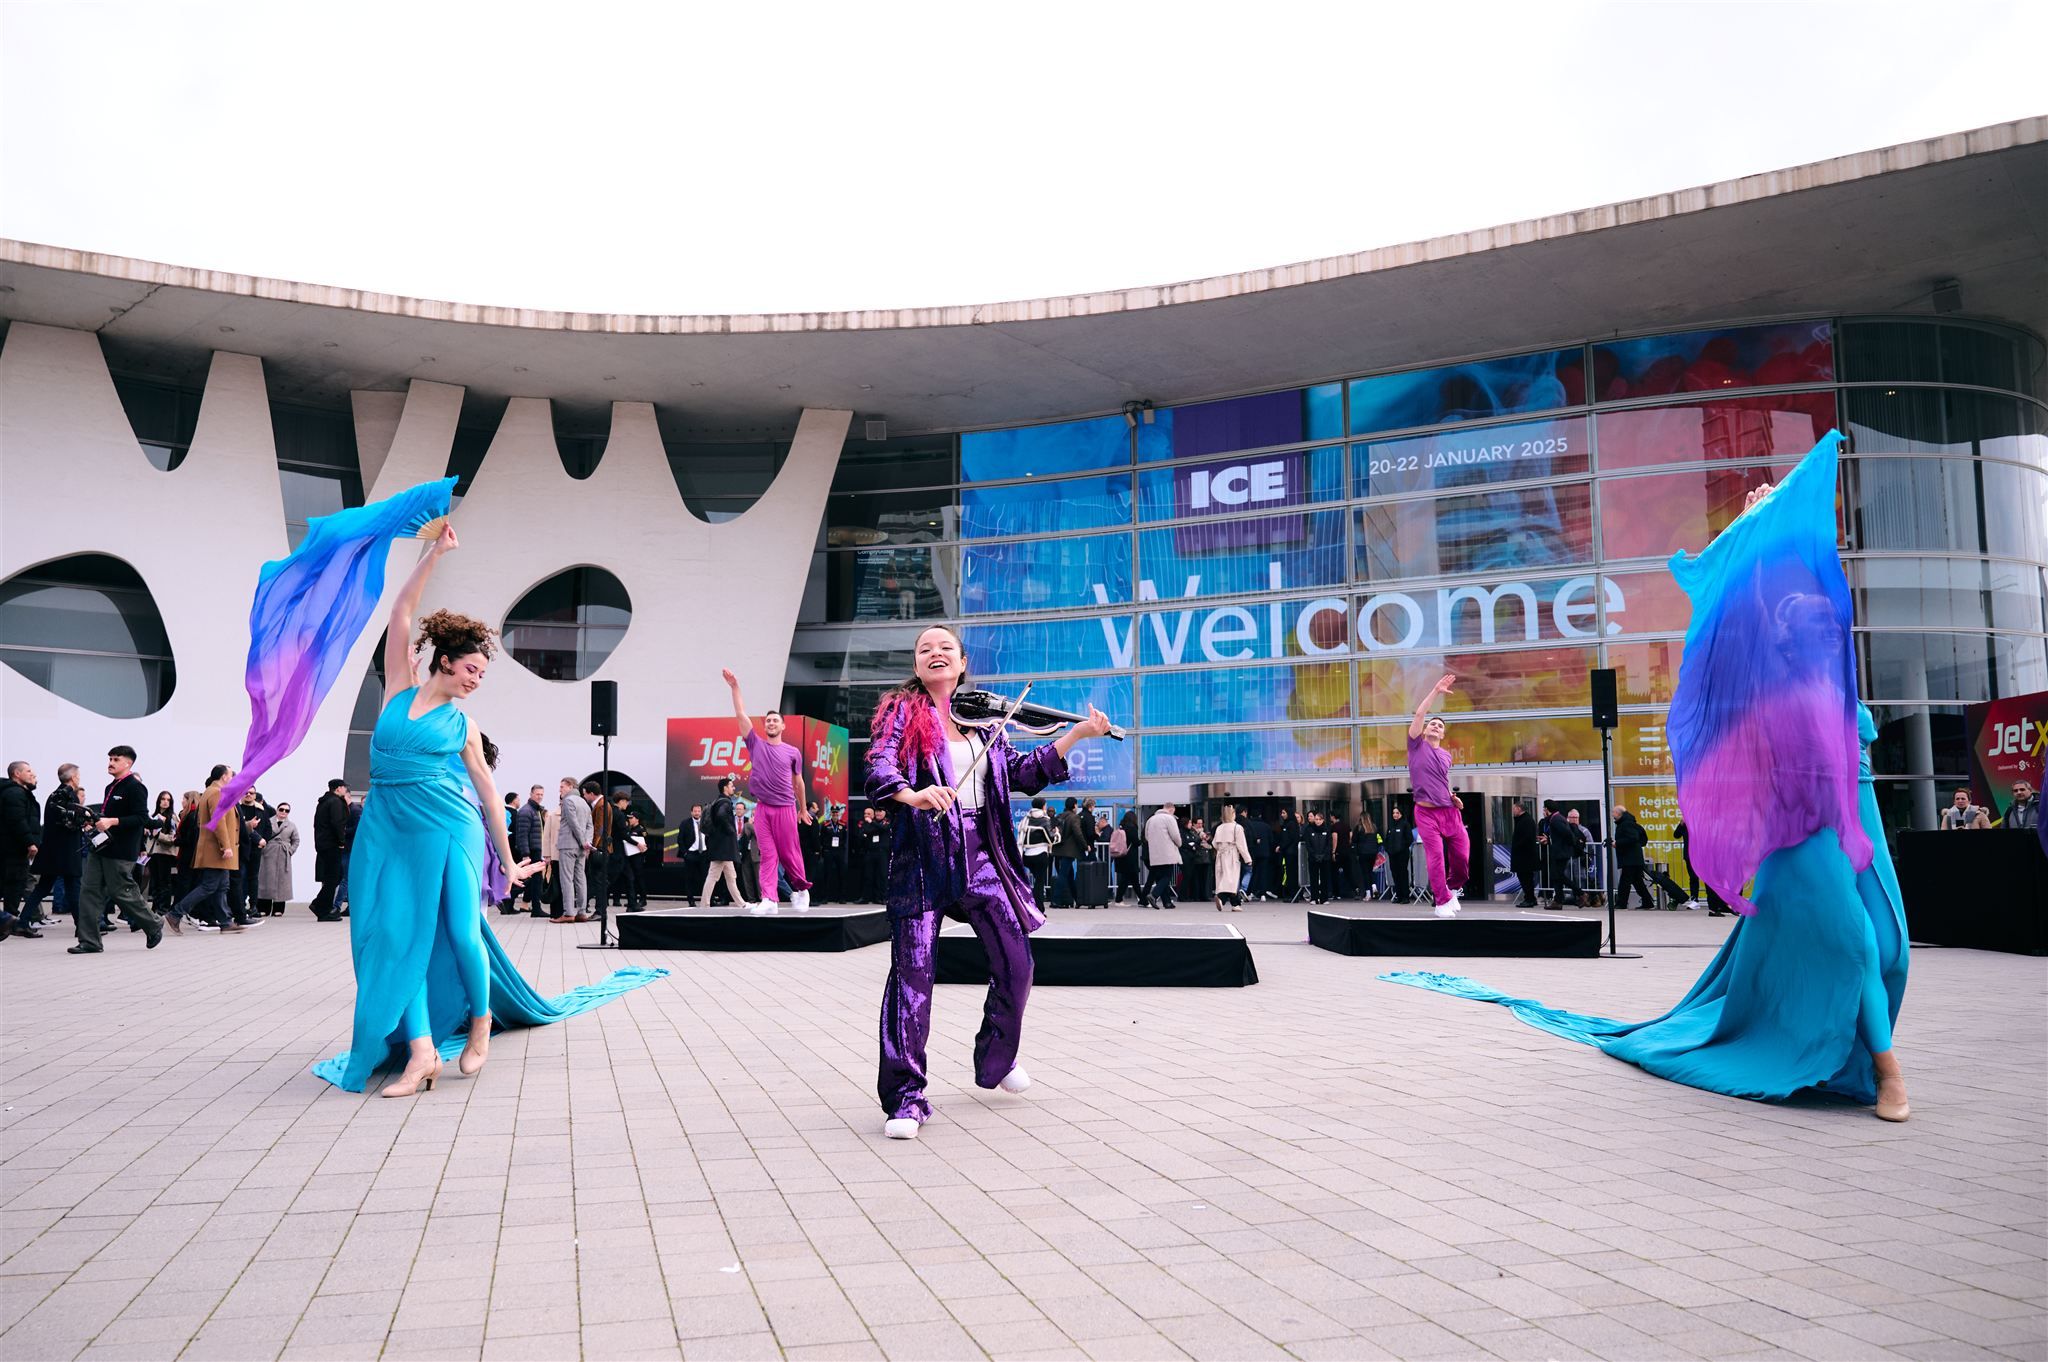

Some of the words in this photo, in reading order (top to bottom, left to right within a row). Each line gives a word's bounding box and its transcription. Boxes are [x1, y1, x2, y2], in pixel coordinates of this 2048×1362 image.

[1369, 456, 1418, 475] 20-22
[1424, 444, 1515, 469] JANUARY
[1521, 437, 1568, 457] 2025
[1190, 461, 1285, 509] ICE
[1093, 561, 1626, 670] Welcome
[689, 736, 752, 771] Jet
[1639, 755, 1660, 766] the
[1640, 809, 1660, 818] the
